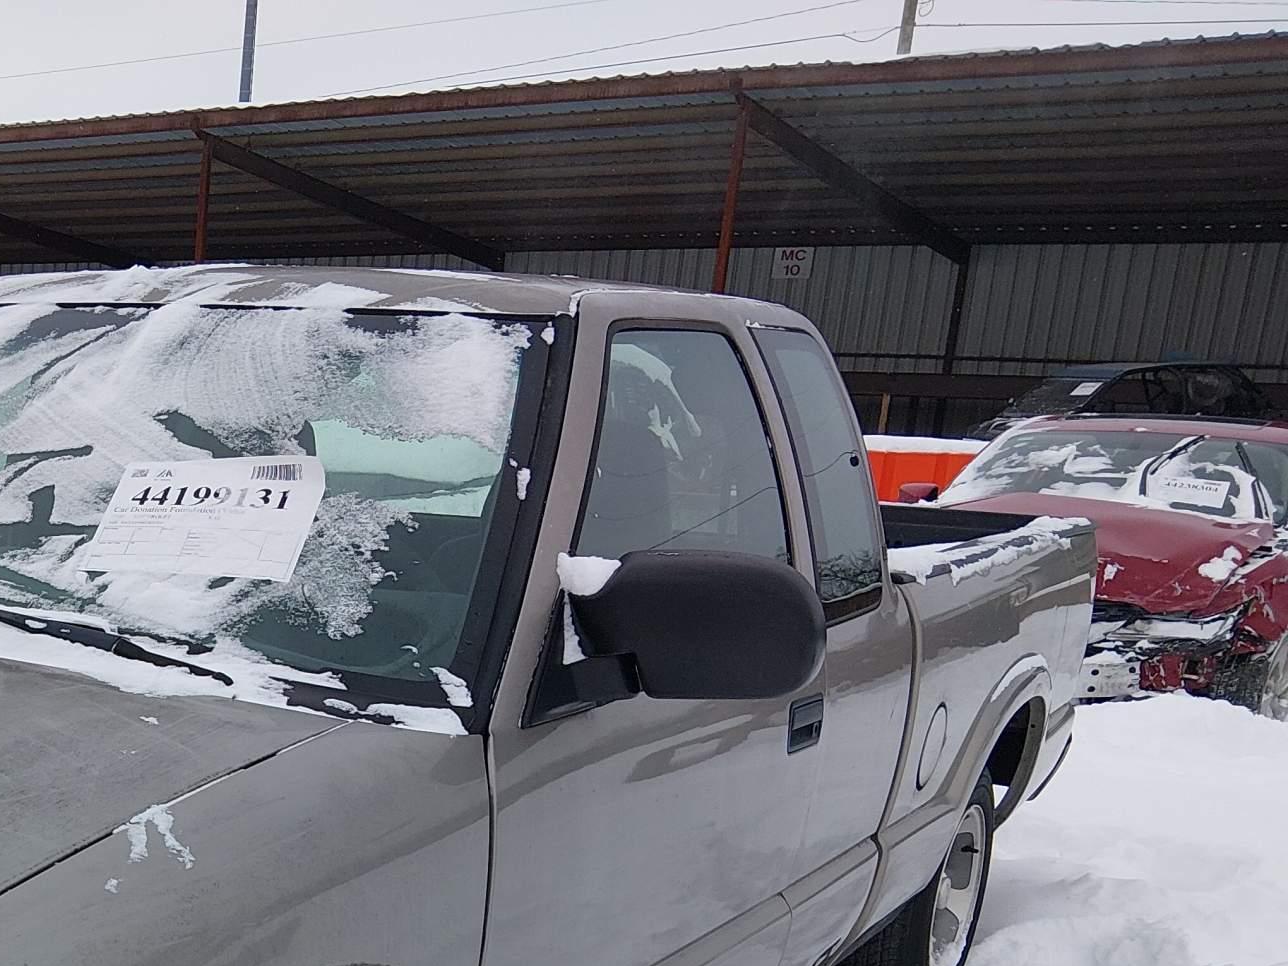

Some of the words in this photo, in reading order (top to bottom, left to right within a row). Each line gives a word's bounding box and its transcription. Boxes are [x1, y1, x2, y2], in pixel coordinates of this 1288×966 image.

[781, 249, 808, 261] MC
[783, 264, 801, 276] 10
[130, 485, 292, 511] 44199131
[129, 506, 169, 514] Donation
